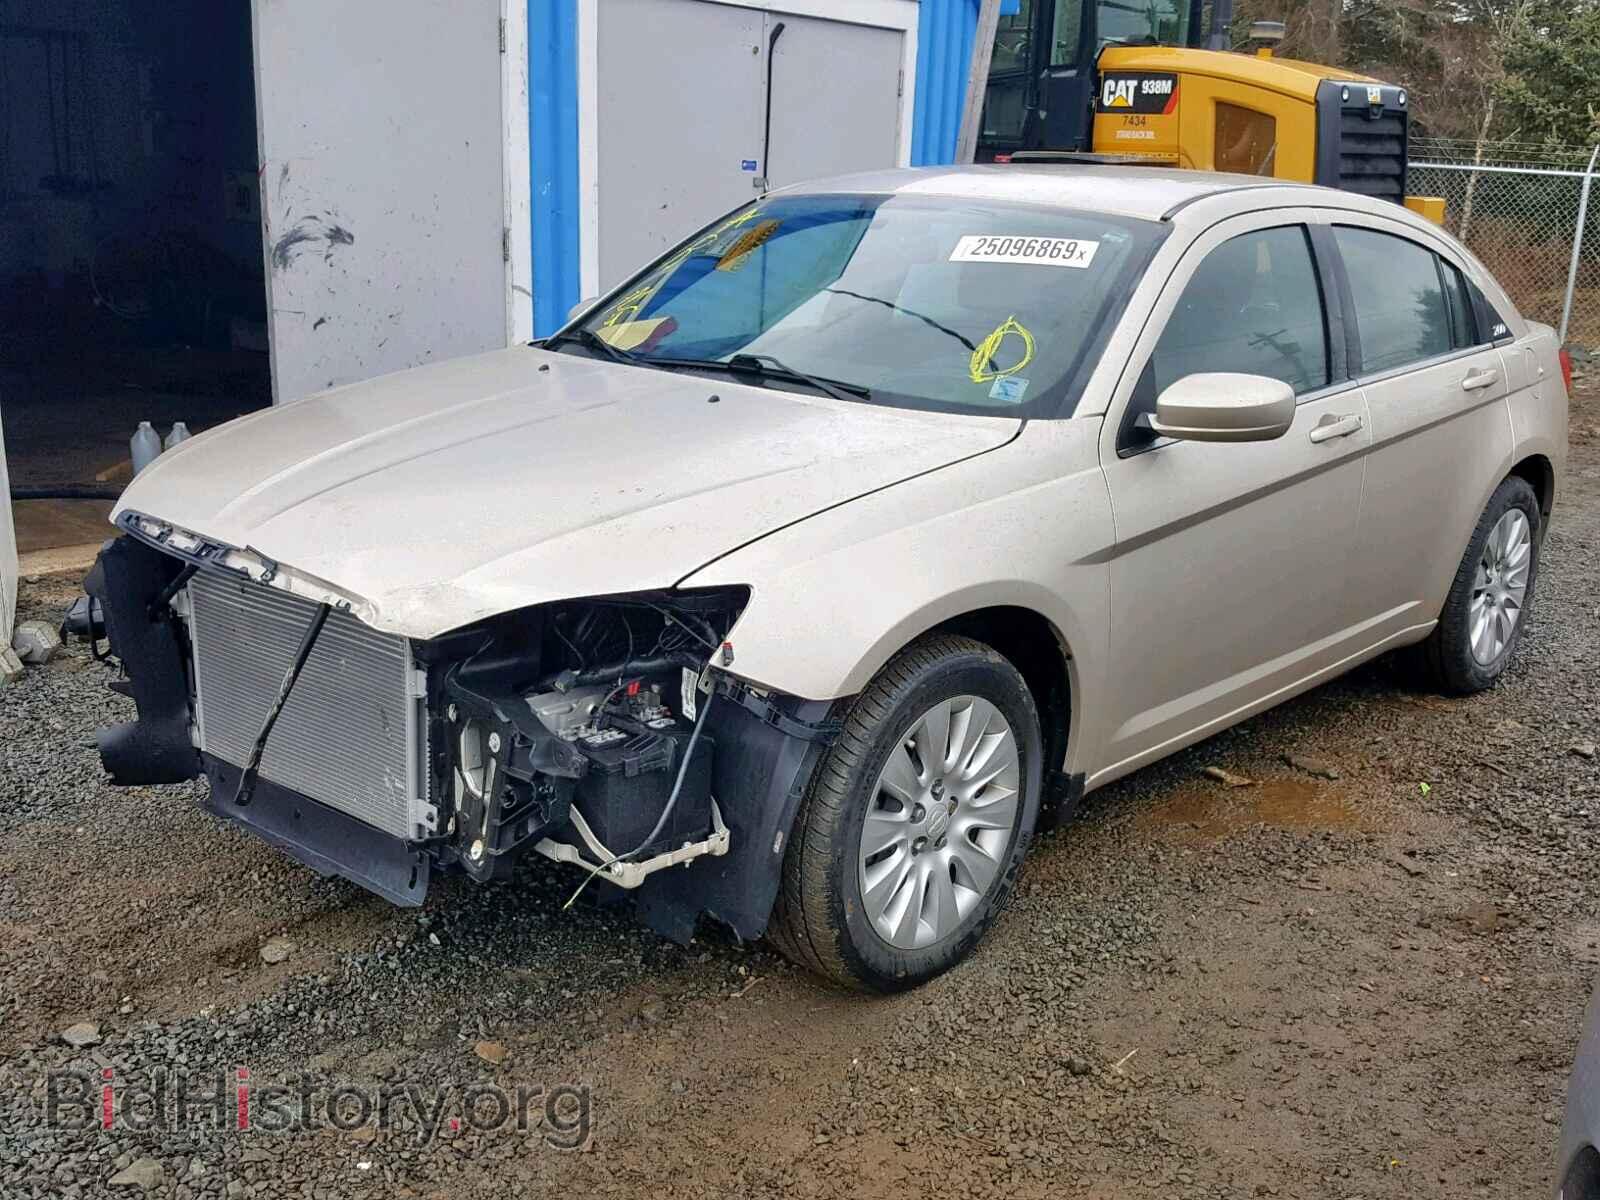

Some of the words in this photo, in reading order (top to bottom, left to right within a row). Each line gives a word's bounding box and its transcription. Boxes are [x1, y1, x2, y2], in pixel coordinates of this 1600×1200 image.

[1103, 79, 1138, 107] CAT
[1142, 80, 1172, 94] 938M
[1121, 115, 1147, 127] 7434
